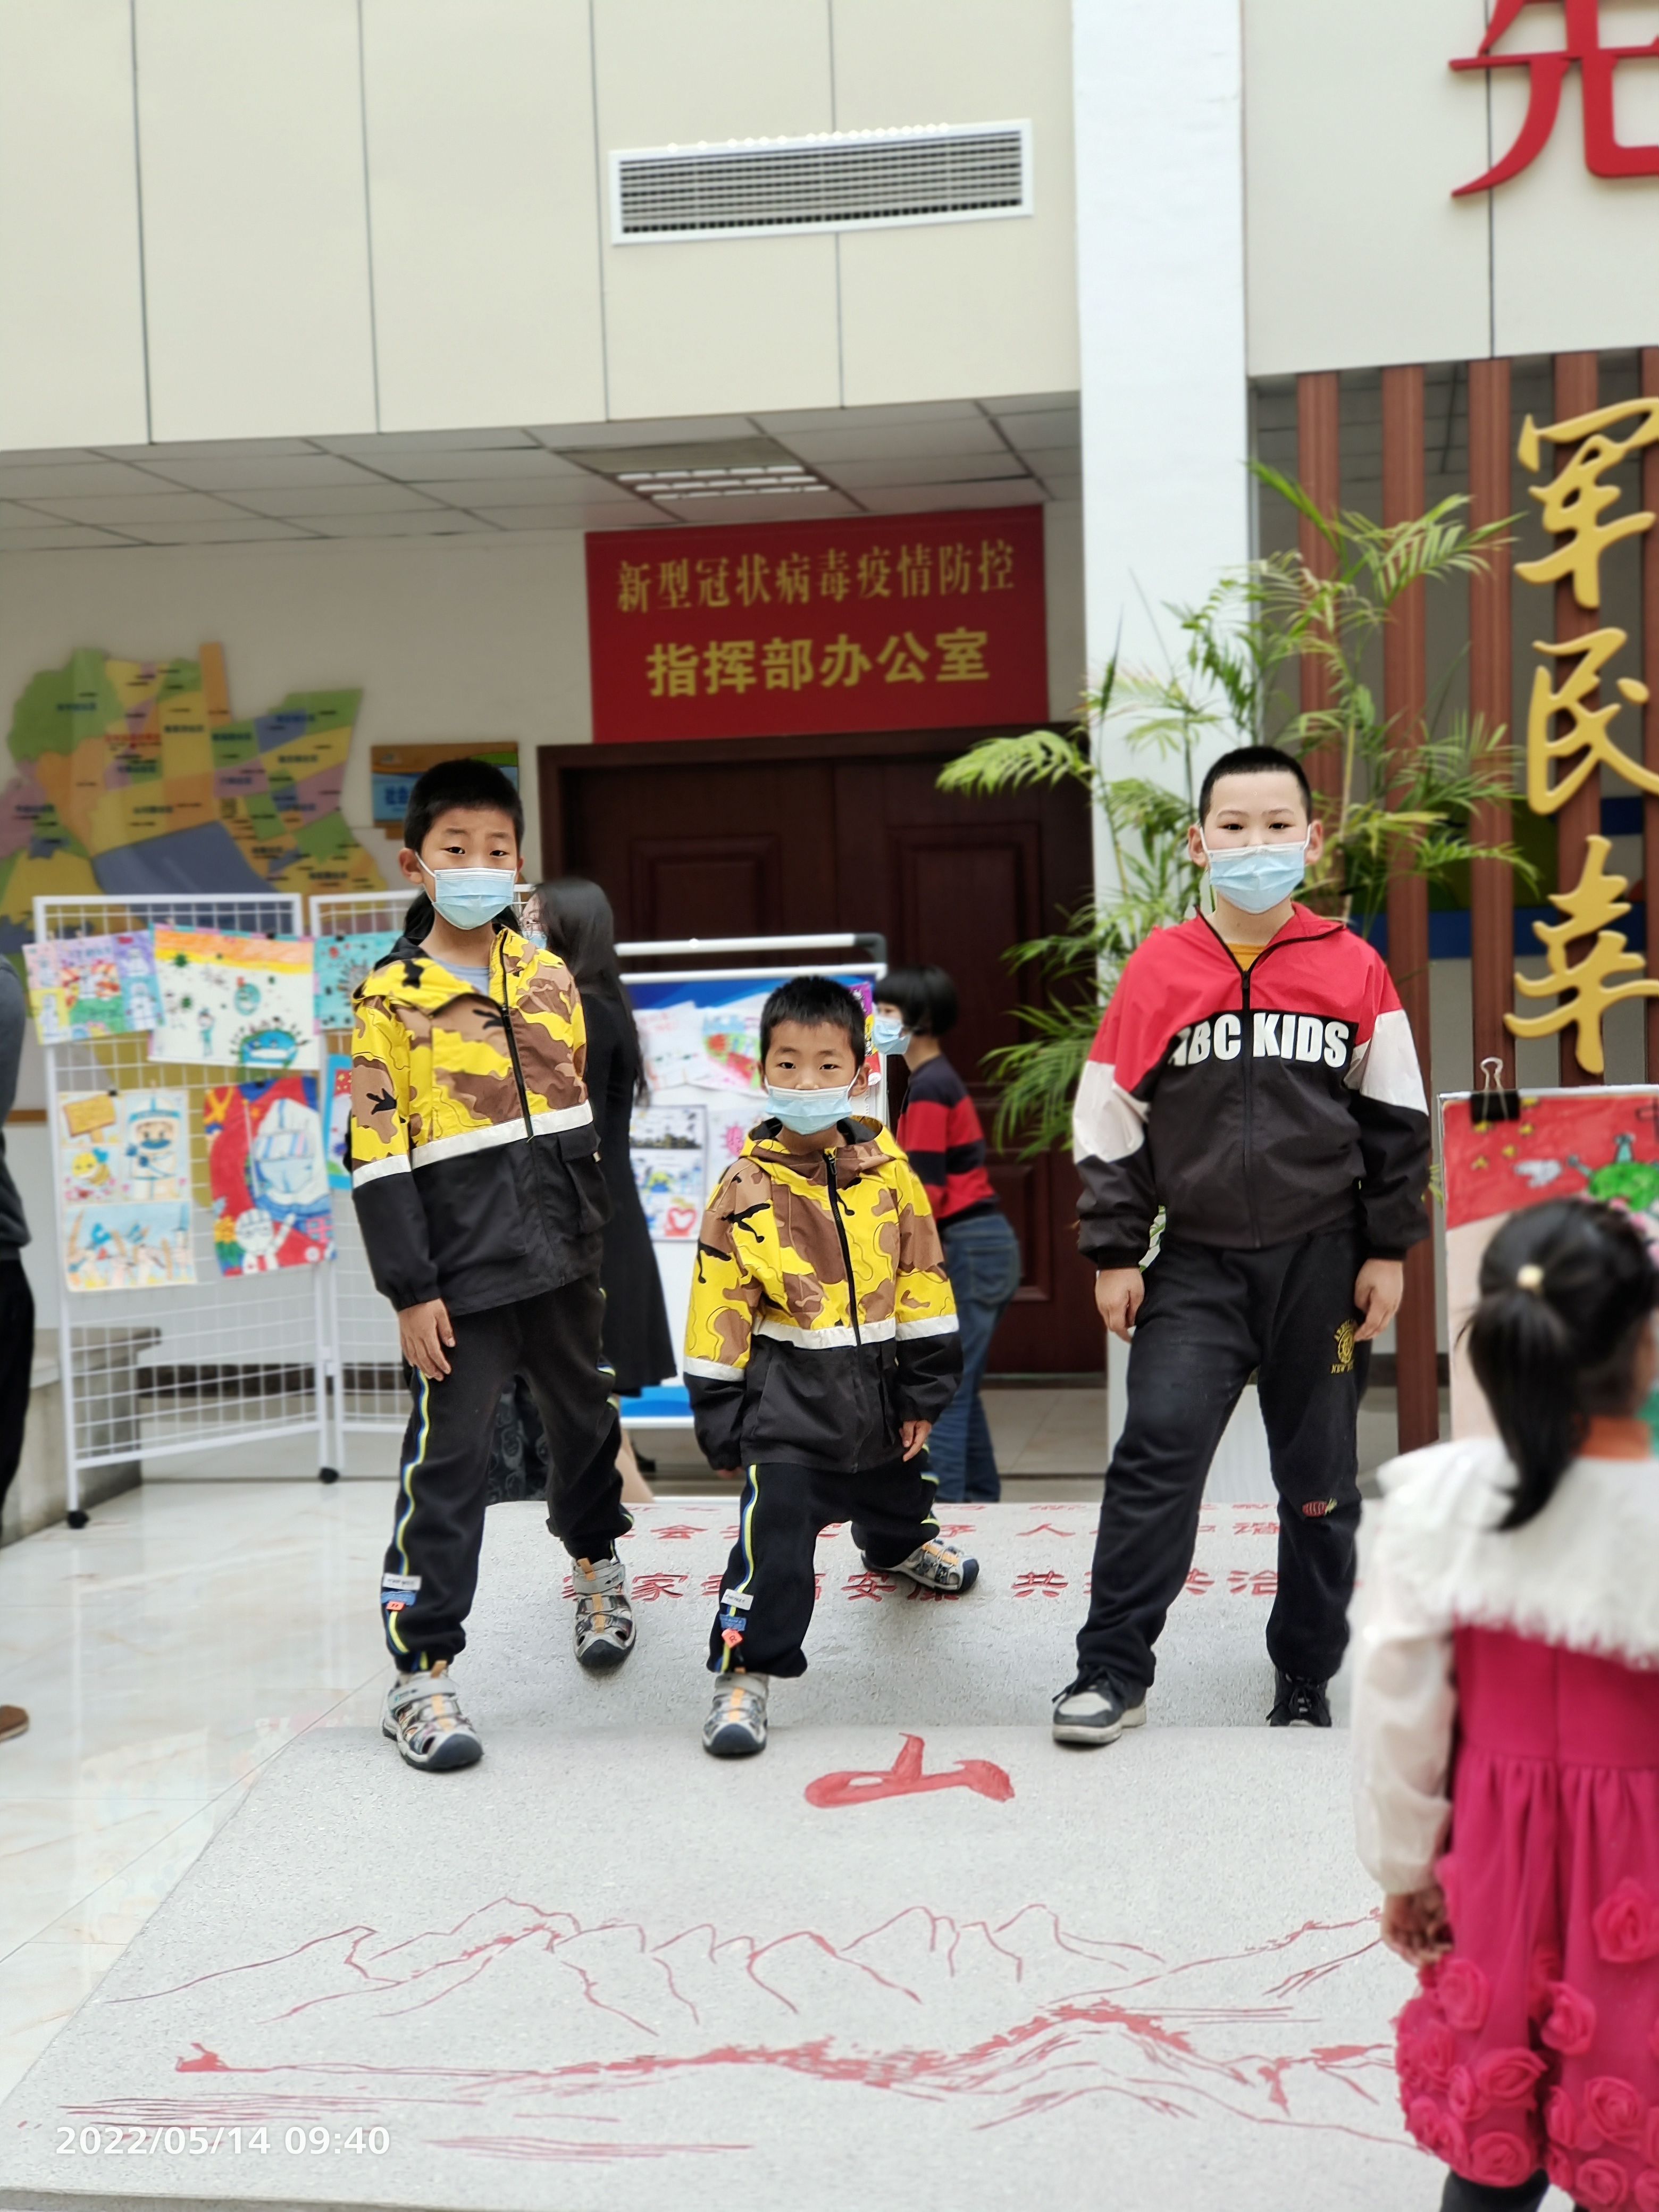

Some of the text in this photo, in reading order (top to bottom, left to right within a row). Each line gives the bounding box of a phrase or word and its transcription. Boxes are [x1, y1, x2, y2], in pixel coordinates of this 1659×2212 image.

[617, 538, 1016, 613] 新型冠状病毒疫情防控
[646, 627, 990, 697] 指挥部办公室
[1253, 1012, 1350, 1068] KIDS
[803, 1732, 1016, 1808] 山
